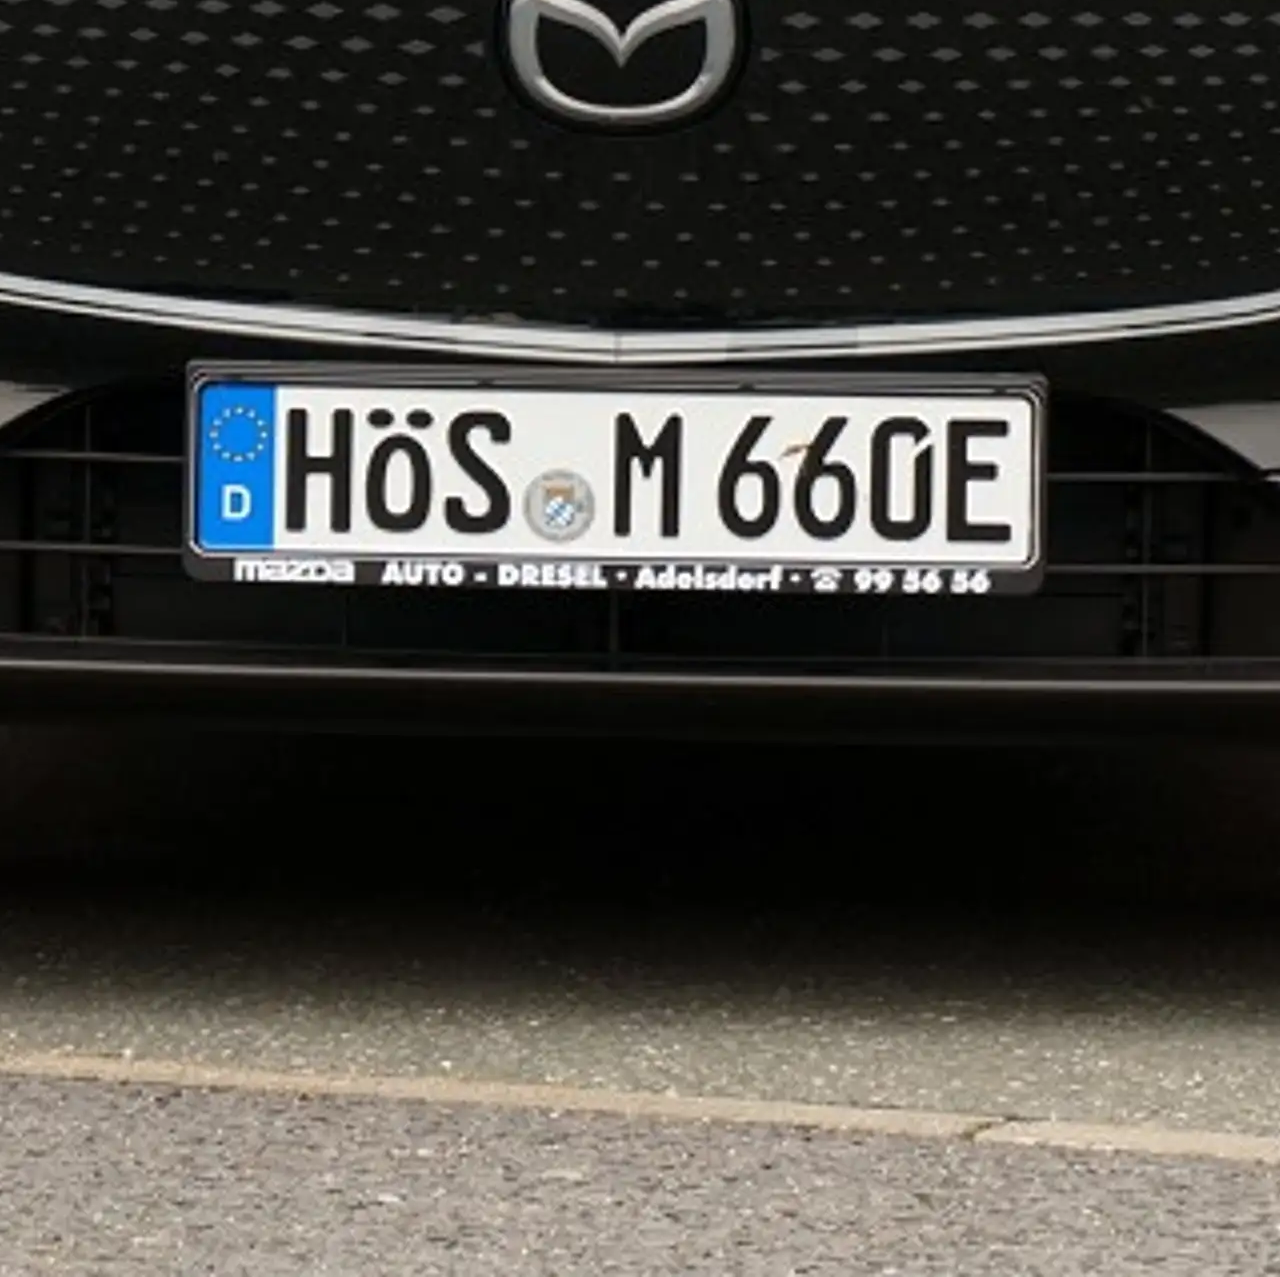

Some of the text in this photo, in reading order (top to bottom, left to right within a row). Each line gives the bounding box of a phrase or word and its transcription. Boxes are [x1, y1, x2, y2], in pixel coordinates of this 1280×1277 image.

[613, 412, 683, 539] M
[718, 415, 1014, 544] 660E
[220, 484, 252, 520] D
[380, 562, 464, 587] AUTO
[497, 563, 609, 590] DRESEL
[633, 564, 783, 592] Adelsdorf
[853, 568, 895, 593] 99
[901, 568, 943, 594] 56
[949, 569, 992, 595] 56
